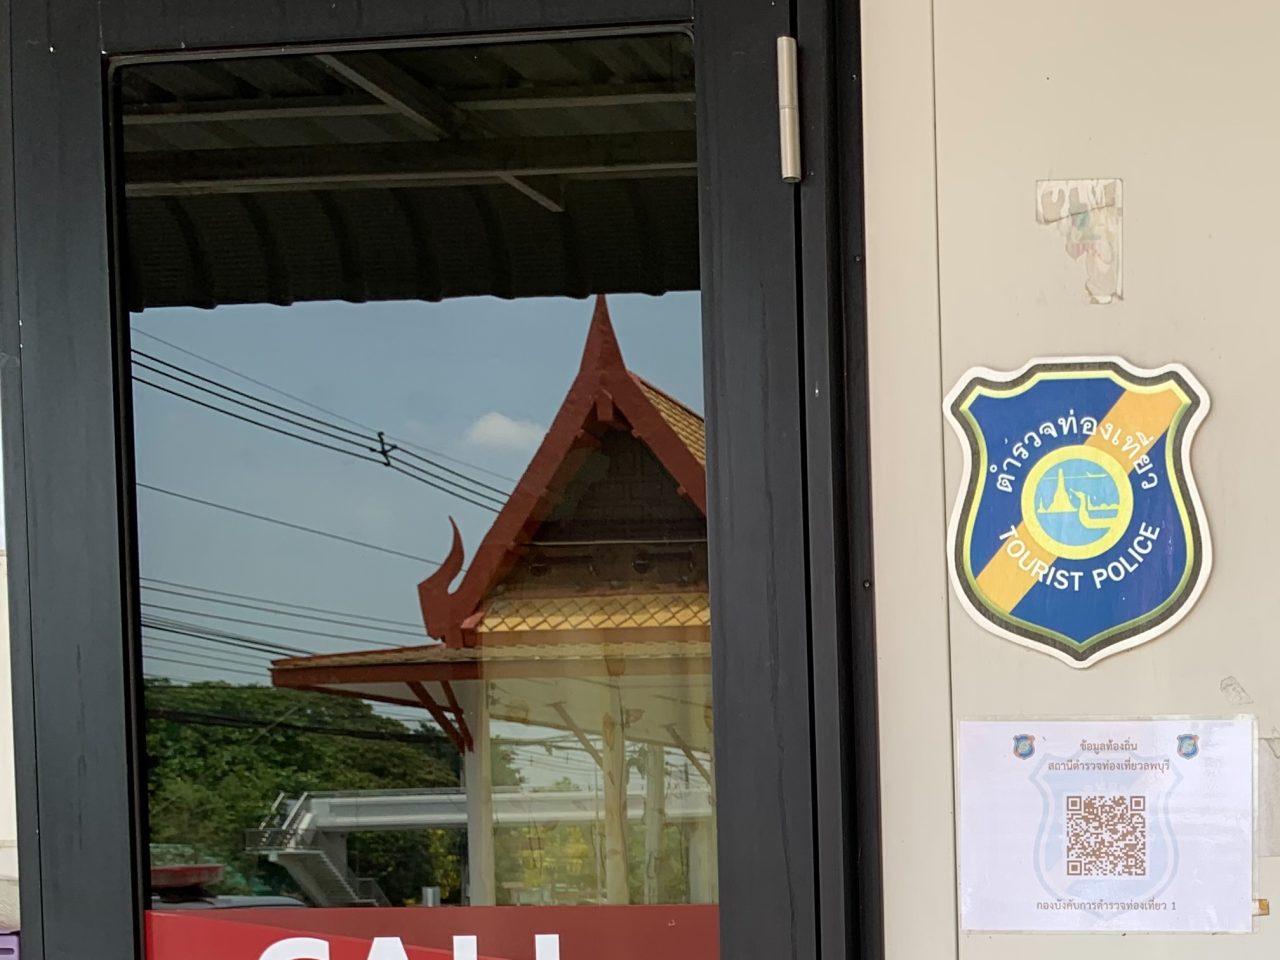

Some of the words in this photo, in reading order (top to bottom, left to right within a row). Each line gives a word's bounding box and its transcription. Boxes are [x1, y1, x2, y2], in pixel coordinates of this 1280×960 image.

[990, 410, 1158, 492] ตำรวจท่องเที่ยว
[999, 525, 1083, 591] TOURIST
[1091, 522, 1160, 589] POLICE
[1172, 901, 1176, 910] 1
